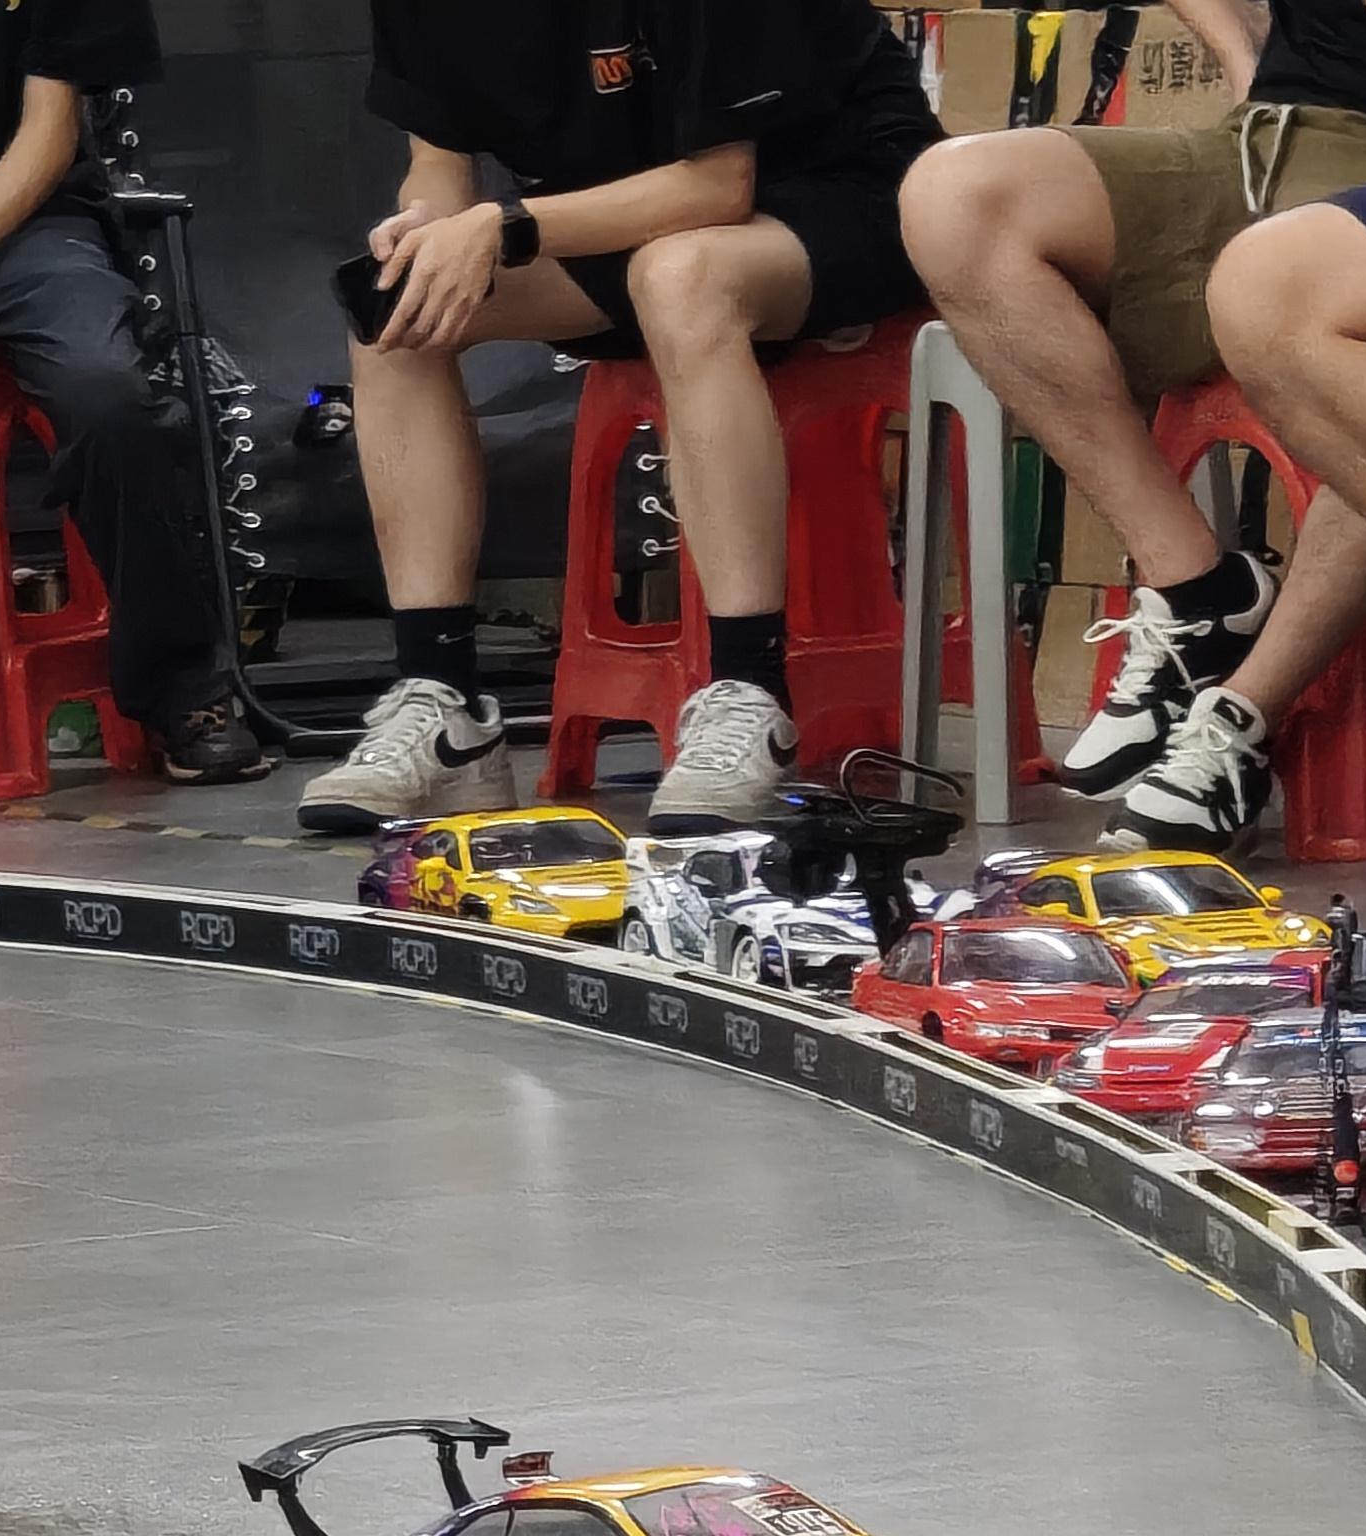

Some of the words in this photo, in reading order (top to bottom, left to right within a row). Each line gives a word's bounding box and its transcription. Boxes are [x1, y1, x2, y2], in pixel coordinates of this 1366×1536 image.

[65, 900, 122, 936] RCPD
[180, 910, 235, 948] RCPD
[391, 937, 438, 975] RCPD
